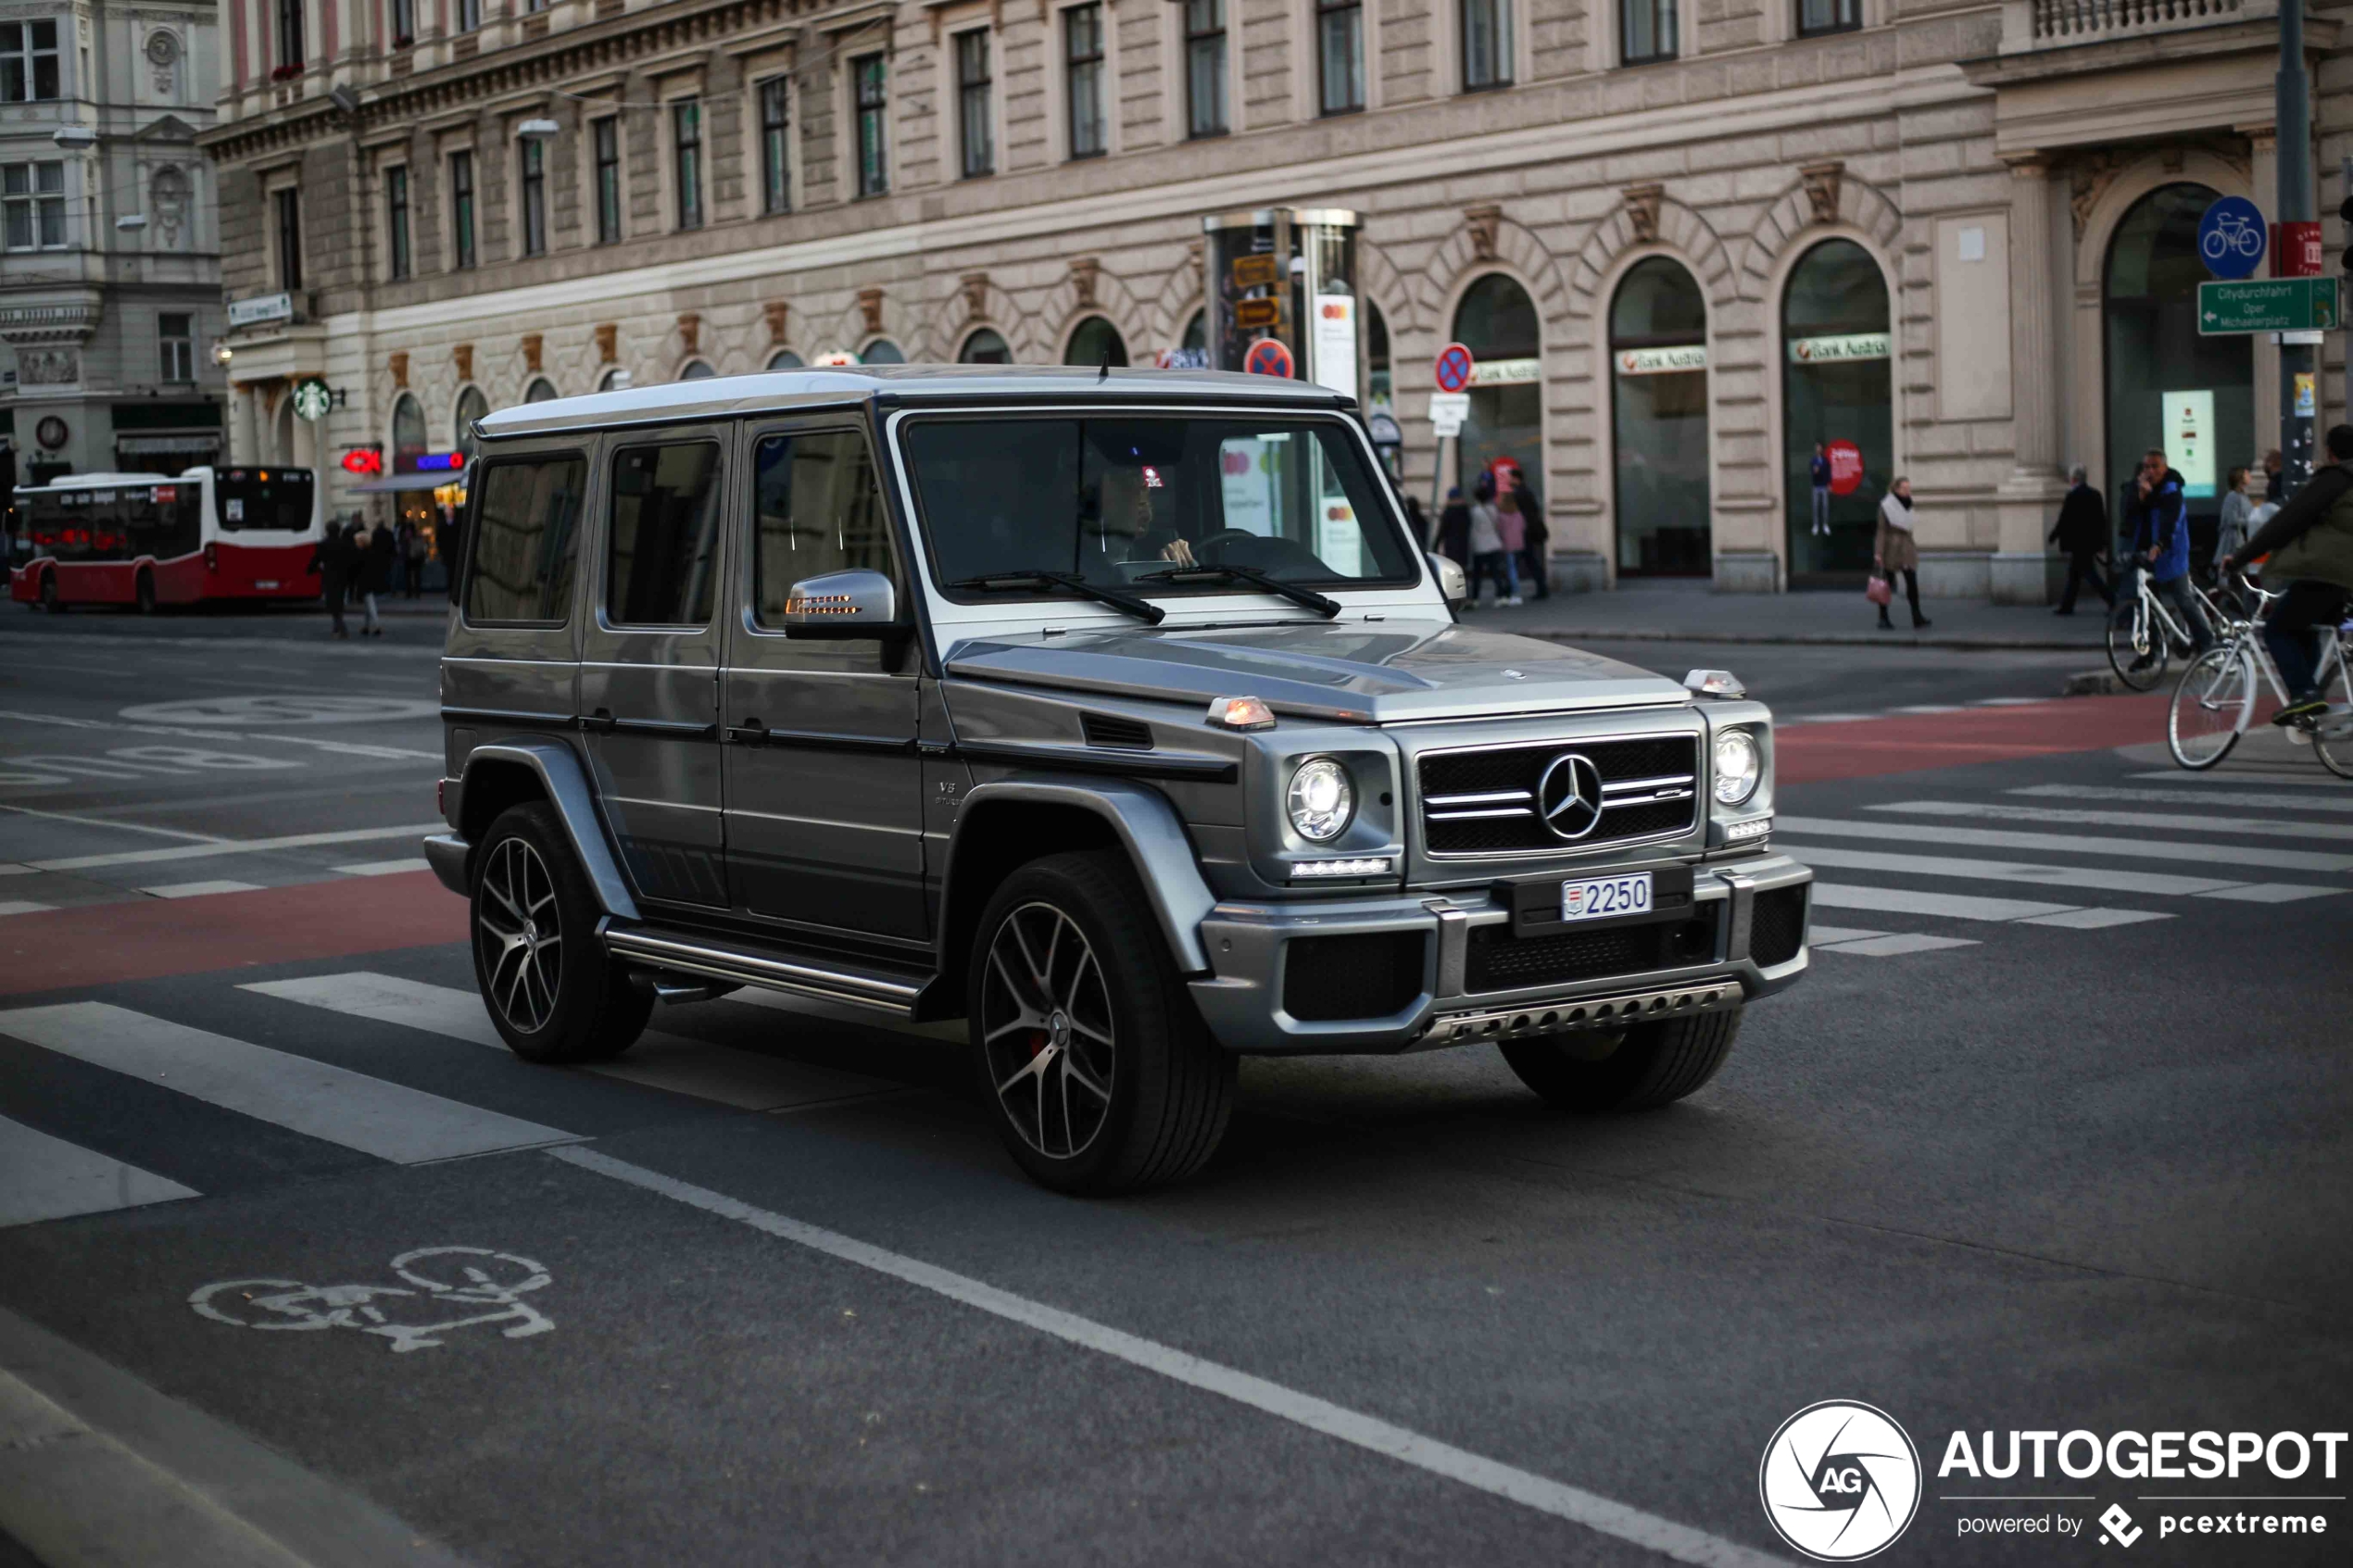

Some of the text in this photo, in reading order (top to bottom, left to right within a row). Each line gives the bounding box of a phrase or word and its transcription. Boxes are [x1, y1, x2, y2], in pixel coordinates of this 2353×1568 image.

[2218, 286, 2293, 303] Citydurchfahrt
[2243, 303, 2266, 317] Oper
[2221, 315, 2291, 329] Michaelerplatz
[1807, 339, 1888, 358] Bank Austria
[1638, 353, 1664, 369] Bank
[939, 782, 956, 794] V8
[1587, 880, 1646, 914] 2250
